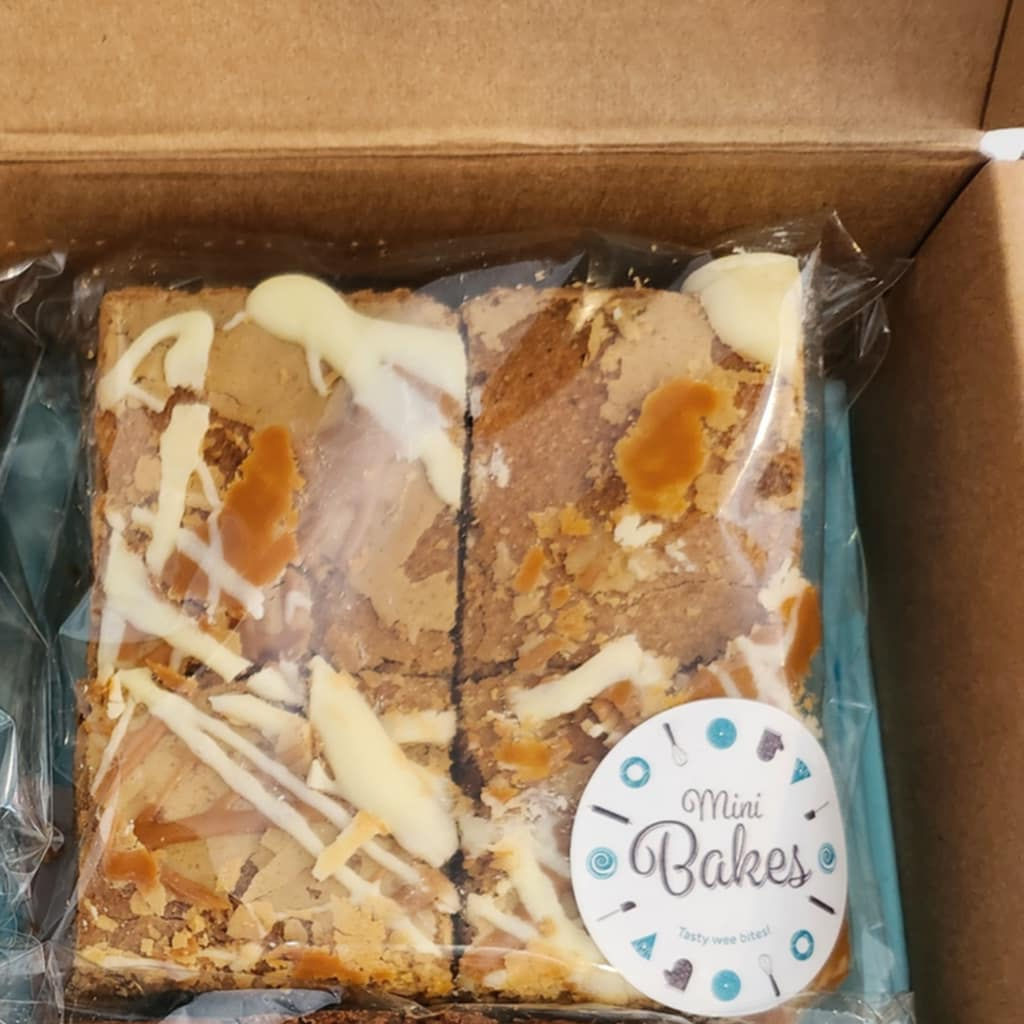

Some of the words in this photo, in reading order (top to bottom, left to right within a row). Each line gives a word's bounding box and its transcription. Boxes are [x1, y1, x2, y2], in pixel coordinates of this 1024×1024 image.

[681, 788, 764, 821] Mini
[629, 820, 812, 897] Bakes
[678, 926, 710, 946] Tasty
[712, 934, 738, 945] wee
[740, 925, 771, 943] bites!
